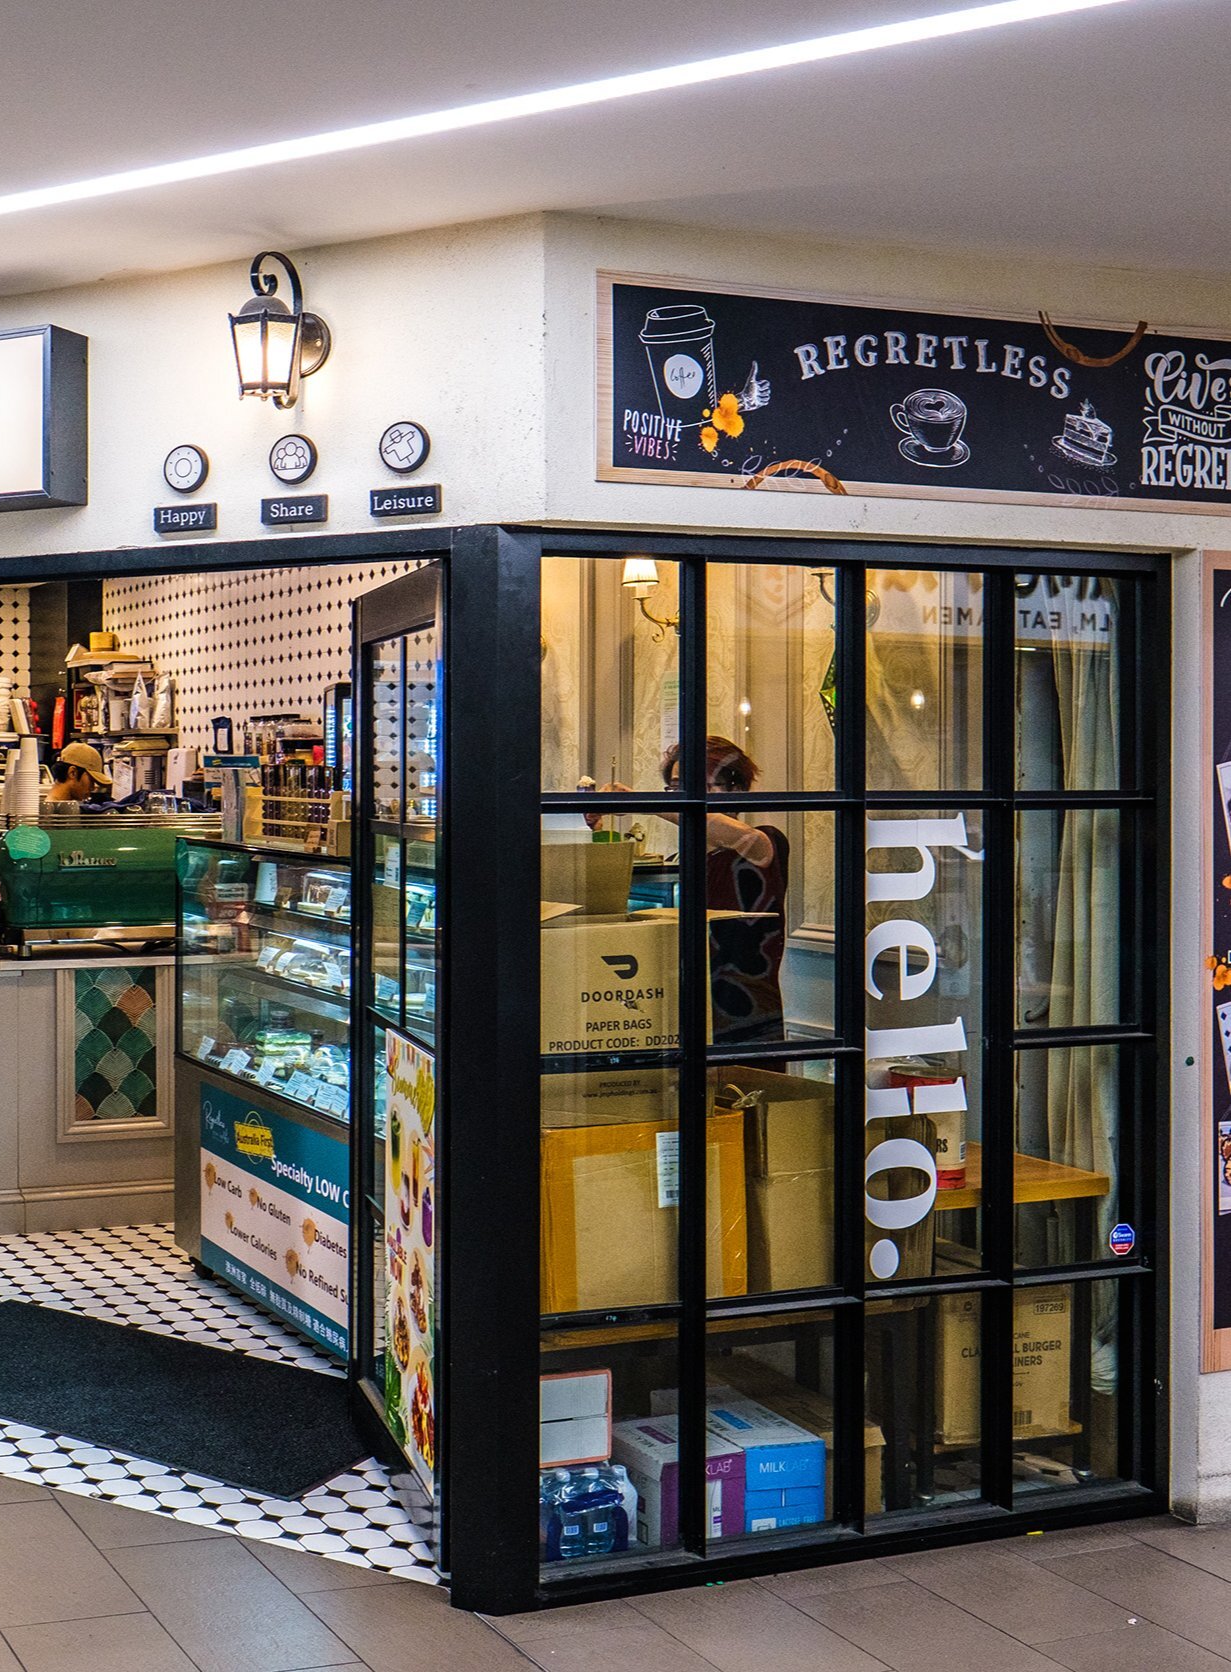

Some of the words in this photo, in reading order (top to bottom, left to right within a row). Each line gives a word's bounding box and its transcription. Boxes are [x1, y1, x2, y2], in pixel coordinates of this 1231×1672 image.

[793, 330, 1073, 399] REGRETLESS
[623, 408, 683, 442] POSITIVE
[1168, 411, 1227, 438] WITHOUT
[634, 436, 670, 460] VIBES
[270, 503, 314, 518] Share
[373, 495, 434, 511] Leisure
[159, 509, 206, 527] Happy
[581, 987, 665, 1003] DOORDASH
[586, 1020, 620, 1032] PAPER
[623, 1018, 652, 1031] BAGS
[549, 1038, 604, 1052] PRODUCT
[606, 1037, 640, 1049] CODE:
[865, 812, 985, 1279] hello.
[236, 1131, 260, 1147] Australia
[214, 1172, 227, 1190] Low
[228, 1180, 243, 1199] Carb
[271, 1154, 314, 1194] Specialty
[315, 1175, 340, 1204] LOW
[257, 1194, 267, 1212] No
[268, 1203, 292, 1226] Gluten
[229, 1221, 250, 1243] Lower
[250, 1234, 278, 1261] Calories
[314, 1229, 348, 1259] Diabetes
[296, 1260, 307, 1279] No
[309, 1270, 339, 1299] Refined
[1034, 1302, 1064, 1313] 197269
[1023, 1339, 1062, 1353] BURGER
